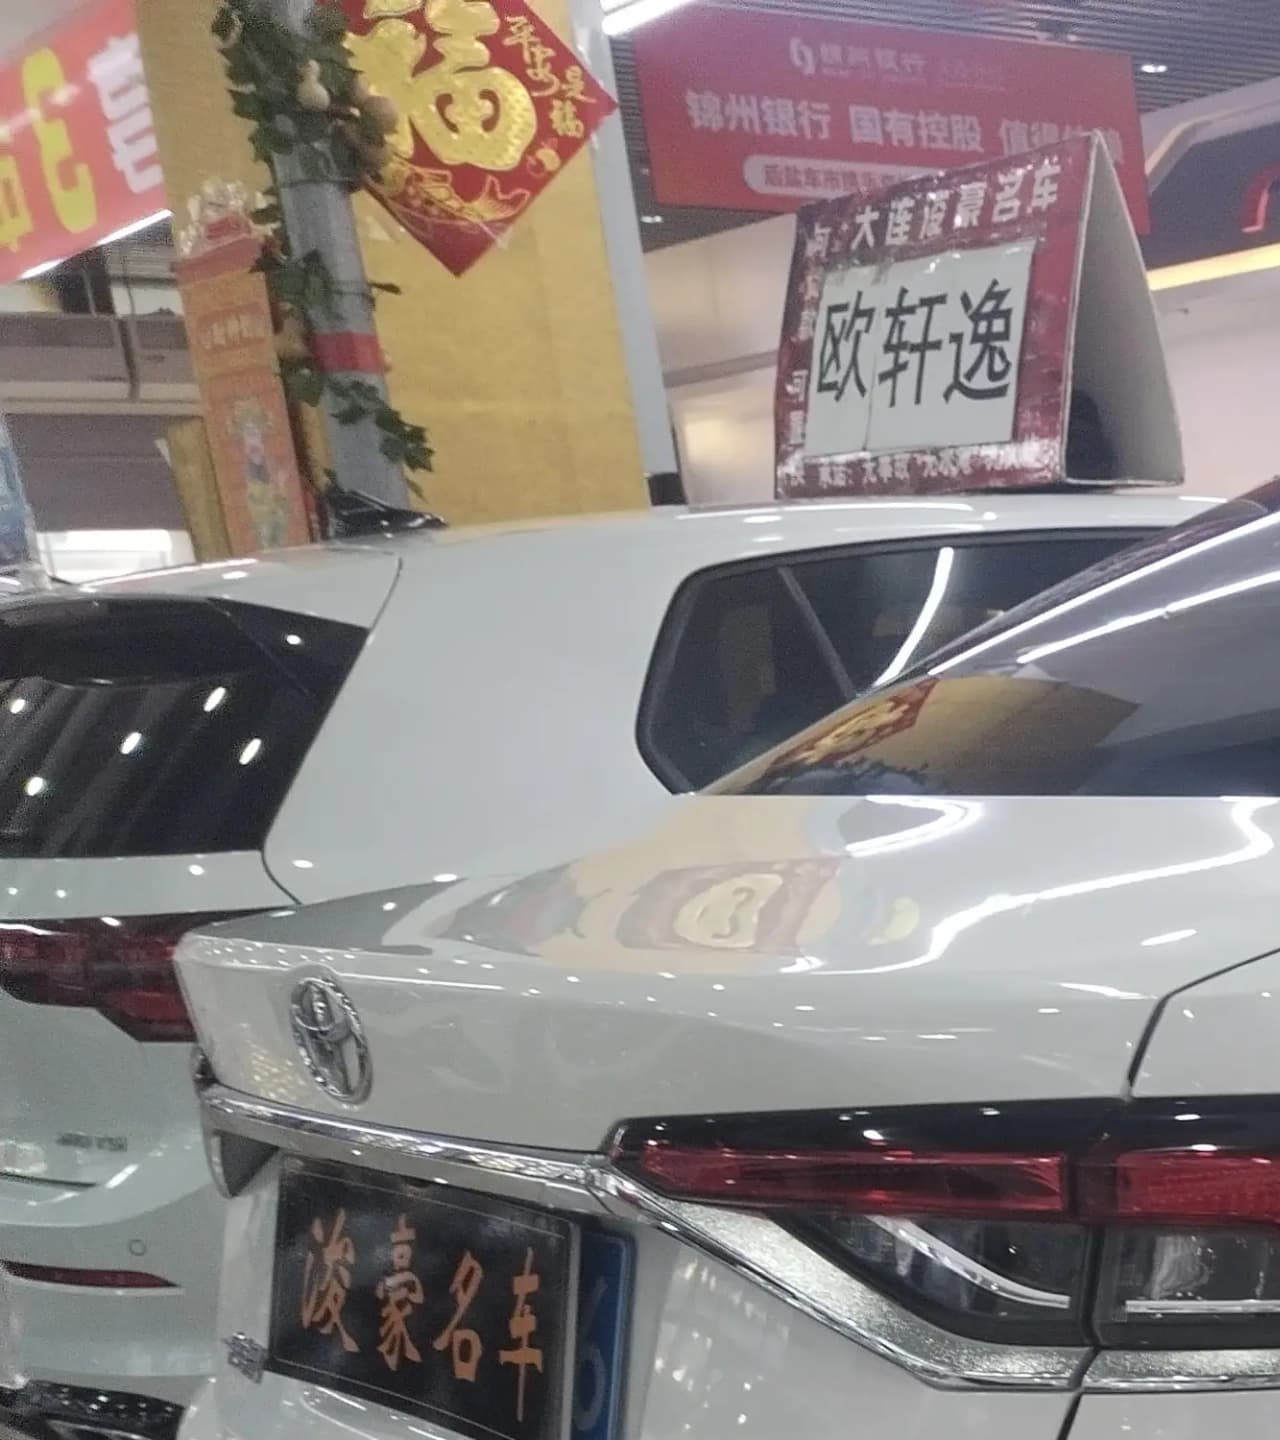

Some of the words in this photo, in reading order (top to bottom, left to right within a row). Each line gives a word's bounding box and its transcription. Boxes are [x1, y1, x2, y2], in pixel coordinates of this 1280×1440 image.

[686, 88, 832, 141] 锦州银行
[848, 102, 985, 154] 国有控股
[1000, 117, 1125, 166] 值得
[815, 278, 1014, 409] 欧轩逸
